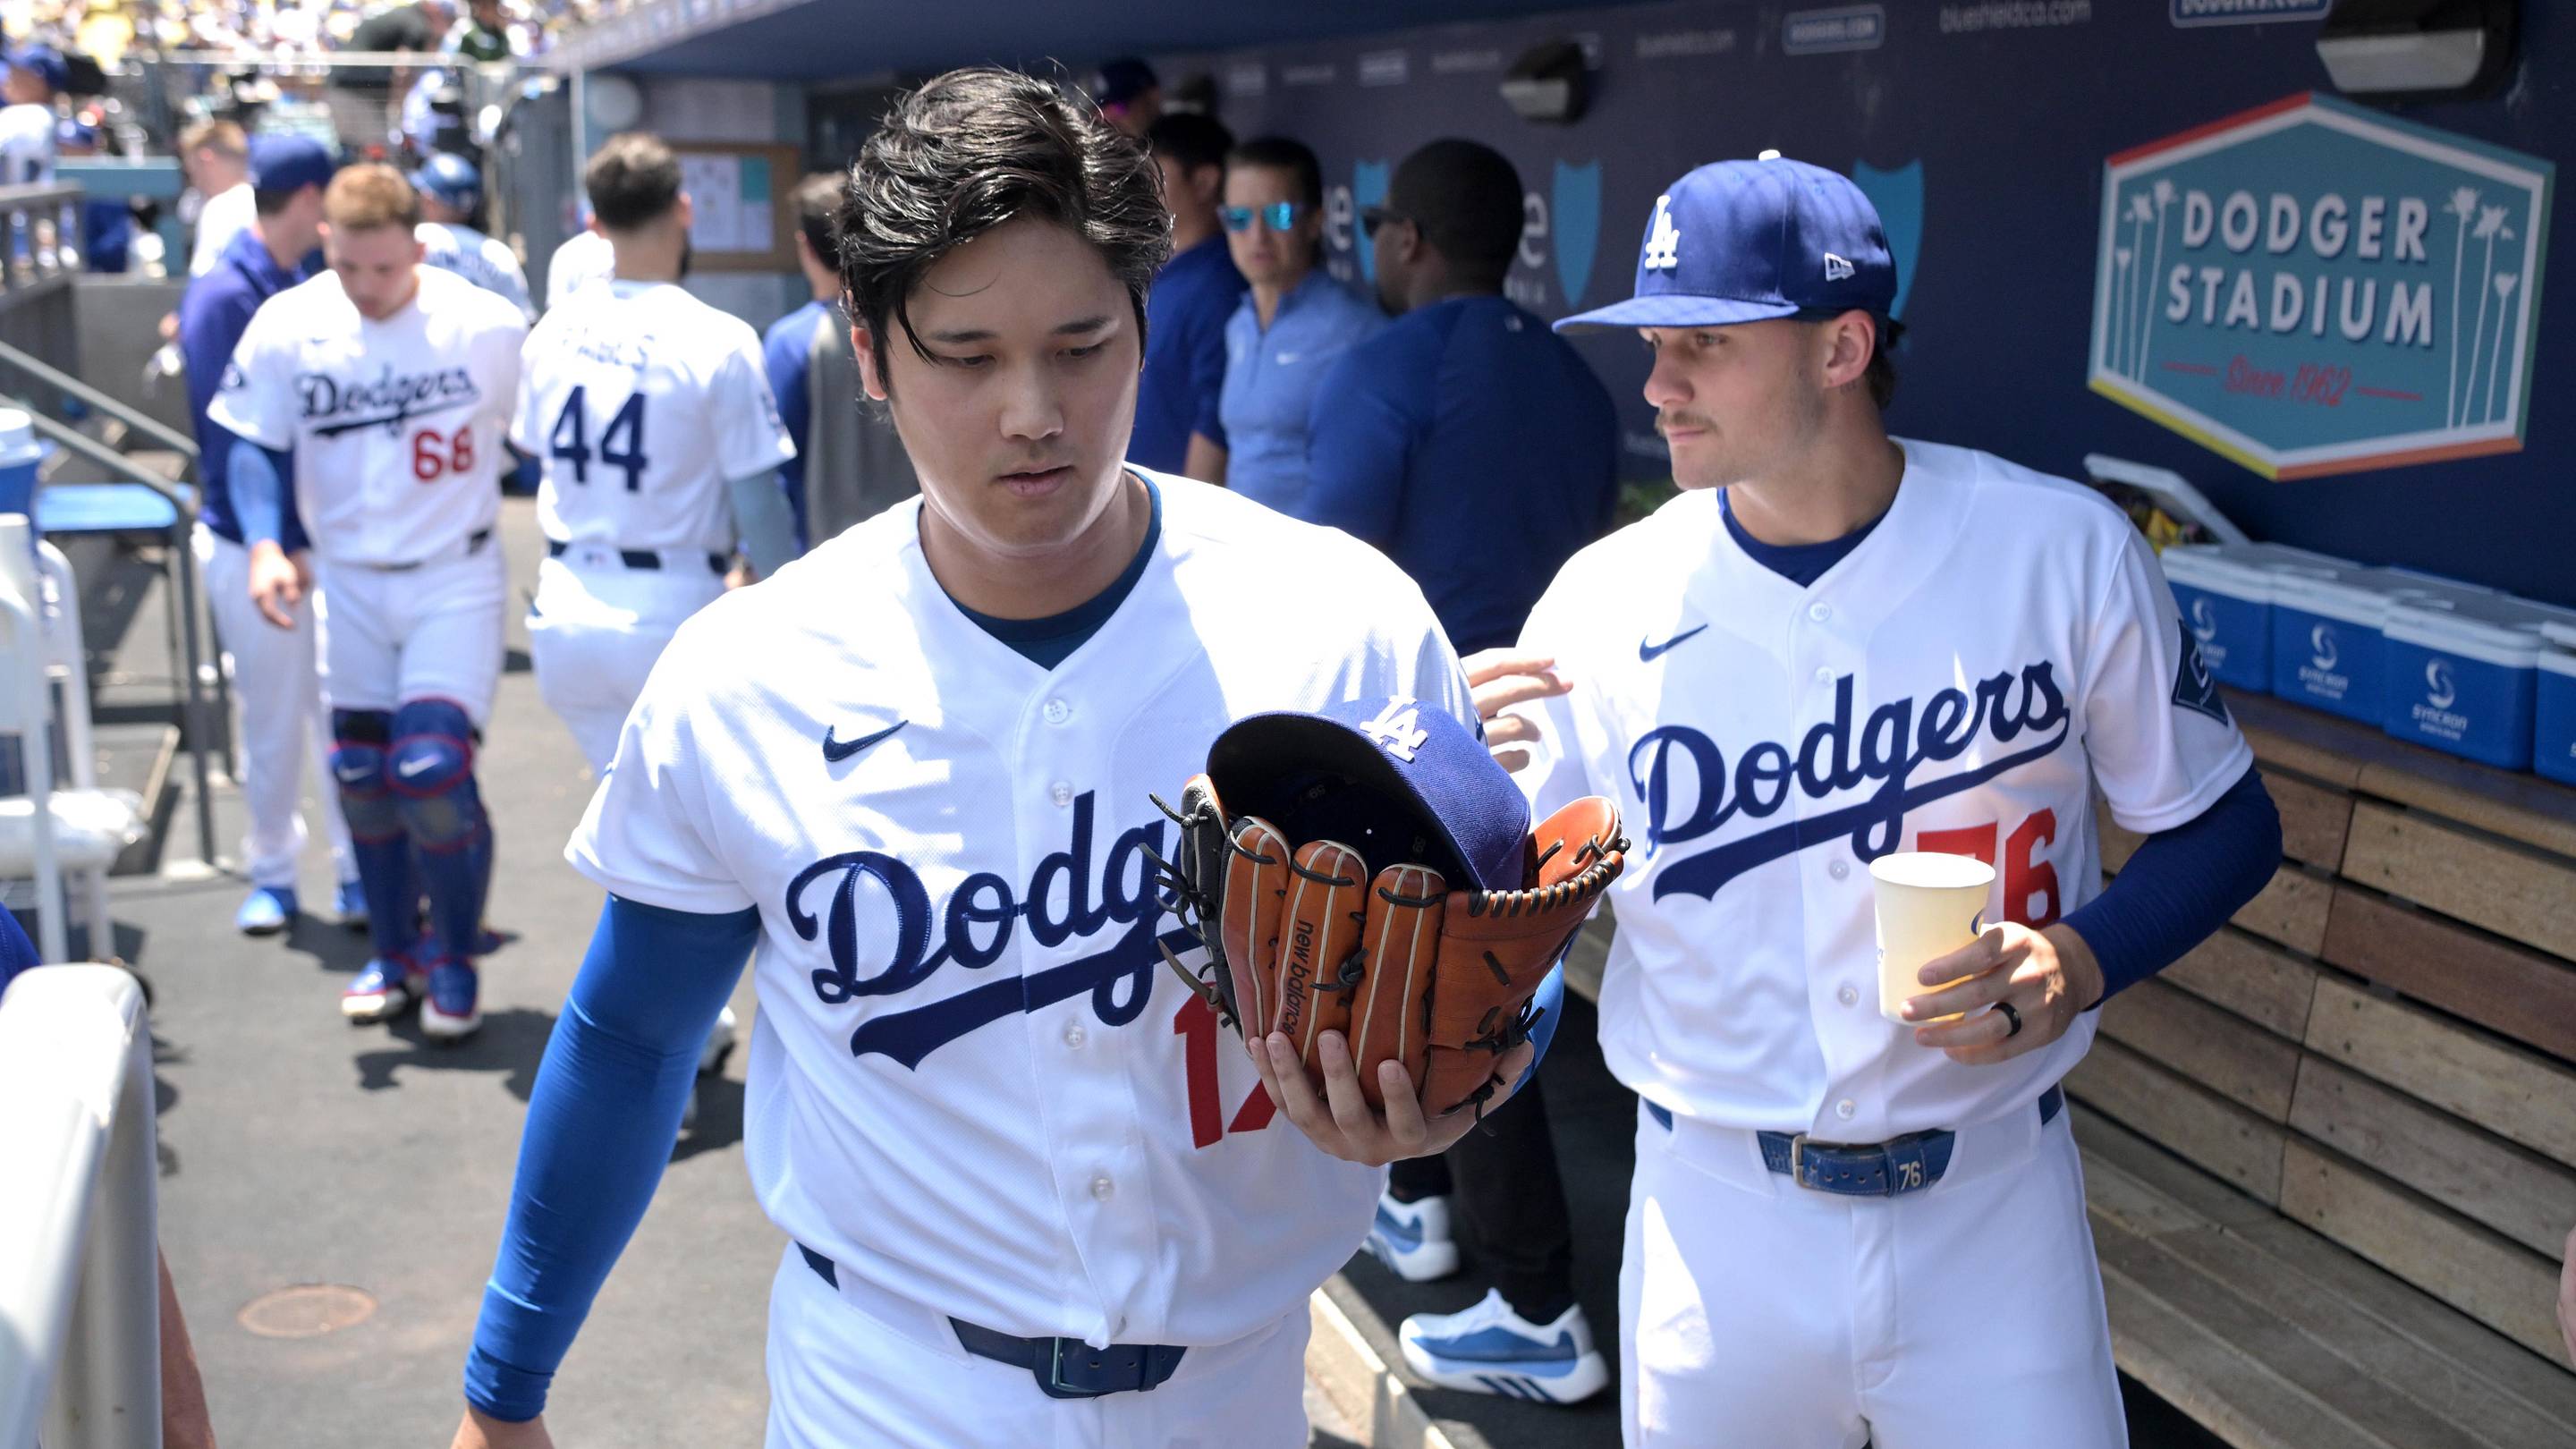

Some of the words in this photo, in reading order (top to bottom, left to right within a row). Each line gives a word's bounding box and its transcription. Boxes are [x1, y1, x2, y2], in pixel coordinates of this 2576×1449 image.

[1645, 195, 1680, 268] LA
[2183, 190, 2428, 260] DODGER
[2165, 263, 2433, 346] STADIUM
[292, 360, 482, 437] Dodgers
[2224, 355, 2285, 396] Since
[2291, 362, 2352, 407] 1962
[413, 426, 474, 483] 68
[551, 385, 648, 491] 44
[1360, 695, 1428, 763] LA
[1629, 660, 2070, 866] Dodgers
[786, 790, 1182, 1026] Dodg
[1297, 919, 1314, 957] new
[1283, 960, 1311, 1038] balance
[1899, 1162, 1921, 1191] 76
